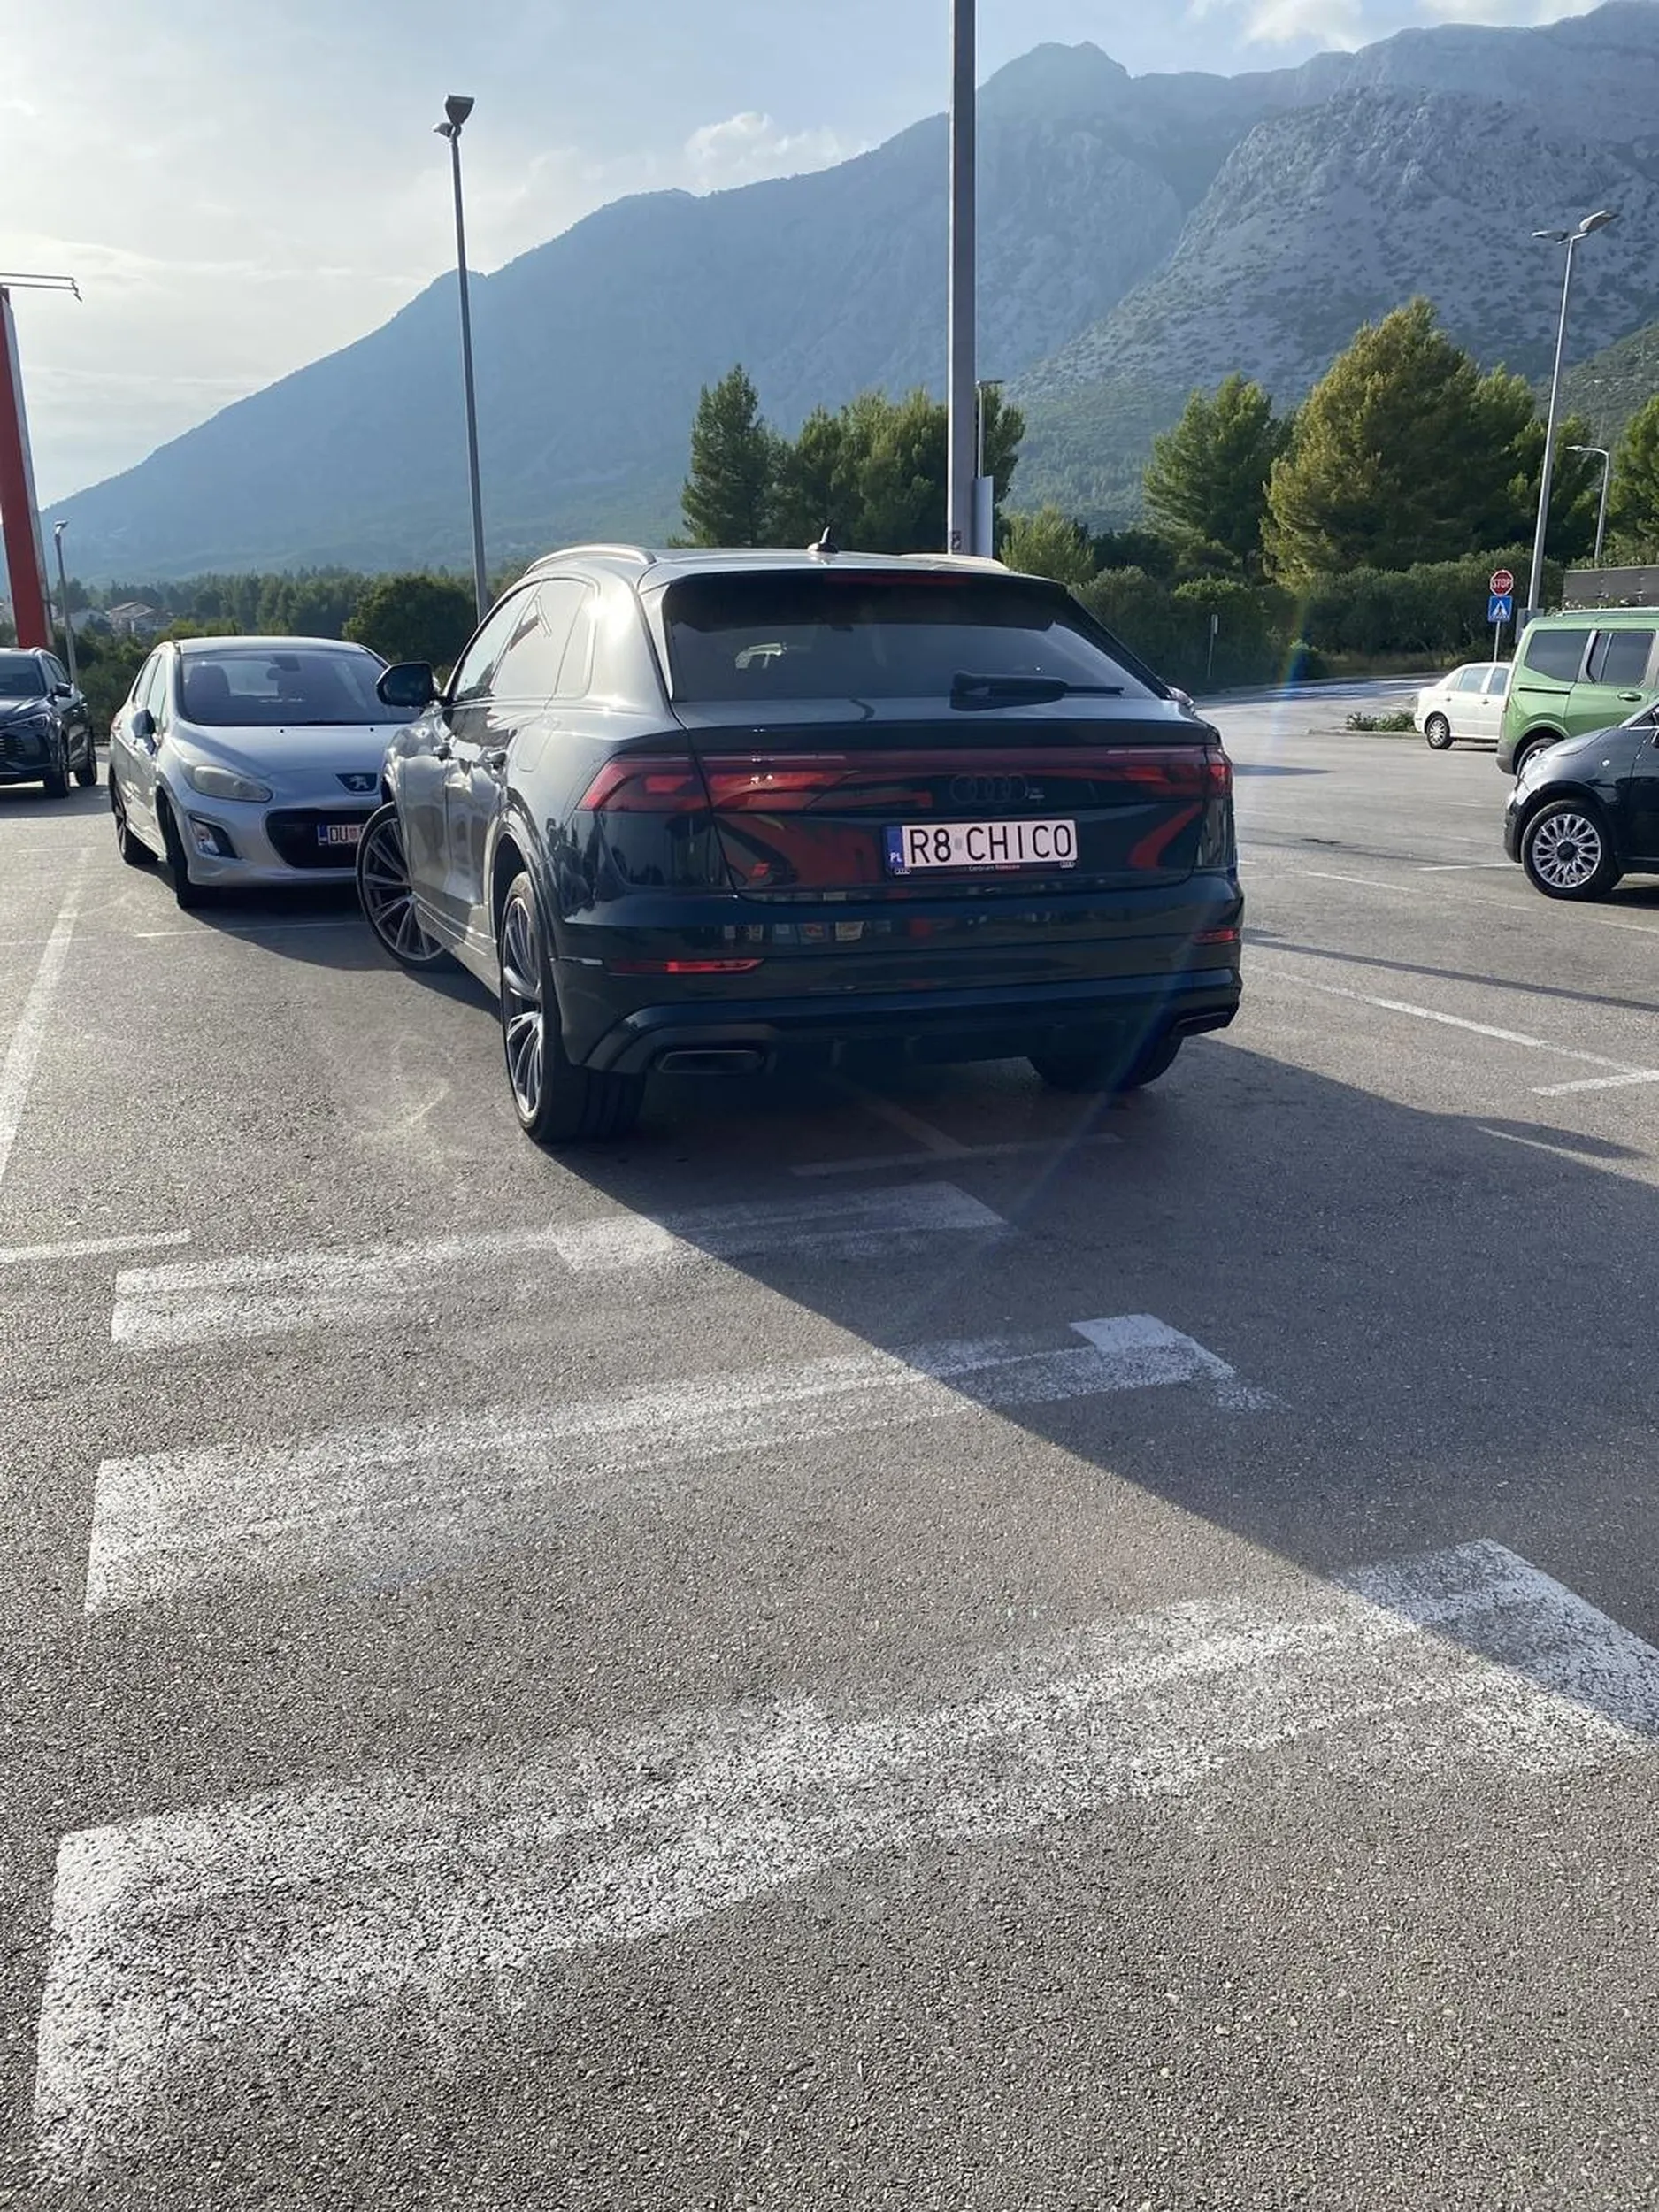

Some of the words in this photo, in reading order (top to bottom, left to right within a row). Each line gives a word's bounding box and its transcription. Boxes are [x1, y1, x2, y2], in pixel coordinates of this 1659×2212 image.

[1492, 578, 1511, 588] STOP
[329, 826, 348, 842] DU
[909, 828, 952, 864] R8
[966, 824, 1071, 861] CHICO
[890, 852, 902, 862] PL
